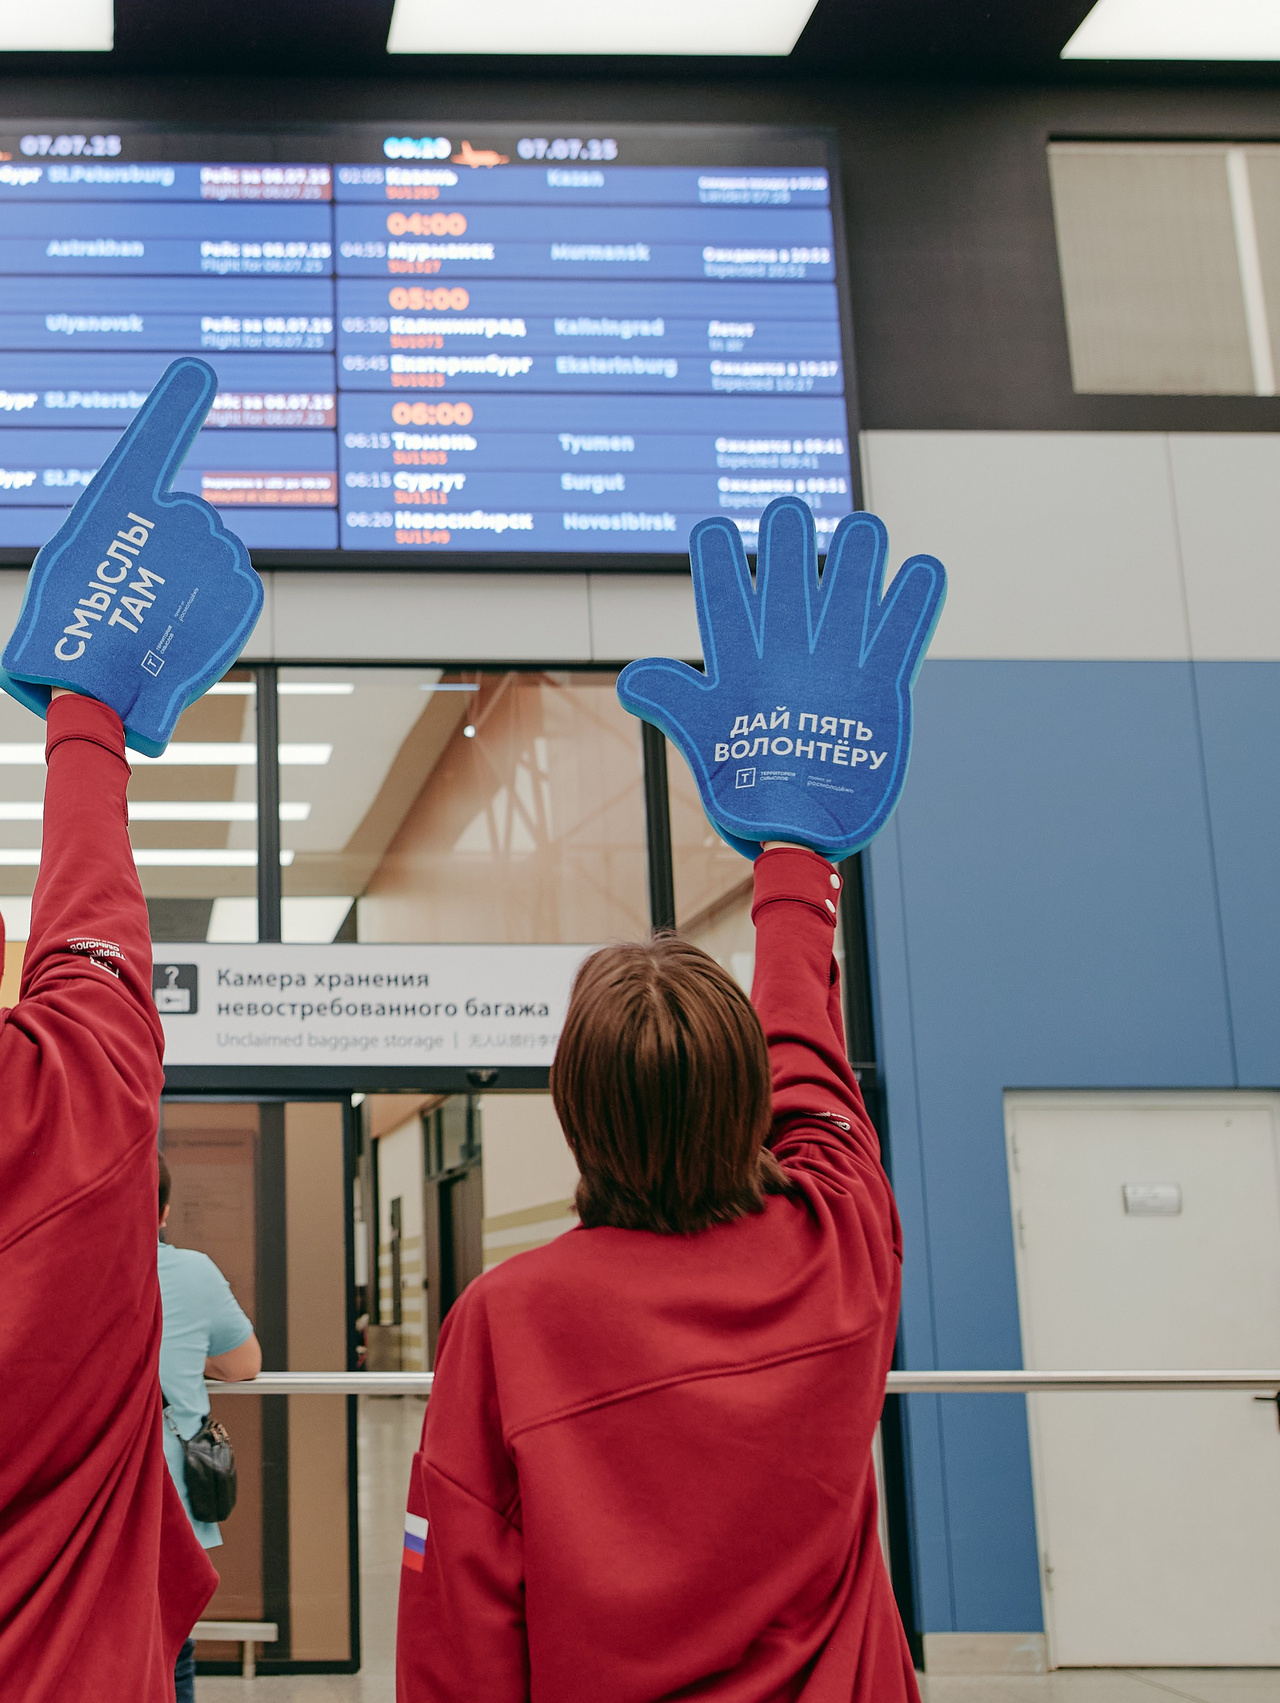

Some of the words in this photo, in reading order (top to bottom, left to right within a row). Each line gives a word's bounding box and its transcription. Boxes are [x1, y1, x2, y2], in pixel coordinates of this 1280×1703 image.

[20, 135, 121, 156] 07.07.25
[386, 211, 467, 236] 04:00
[389, 286, 470, 311] 05:00
[554, 317, 665, 339] Kaliningrad
[390, 354, 534, 377] Екатеринбург
[555, 356, 679, 378] Ekaterinburg
[392, 401, 474, 426] 06:00
[391, 431, 478, 452] Тюмень
[558, 434, 635, 455] Tyumen
[392, 471, 466, 492] Сургут
[560, 473, 625, 494] Surgut
[394, 511, 534, 533] Новосибирск
[563, 513, 678, 532] Novosibirsk
[54, 512, 156, 662] СМЫСЛЫ
[107, 567, 166, 634] ТАМ
[729, 705, 791, 739] ДАЙ
[798, 712, 874, 741] ПЯТЬ
[714, 736, 888, 770] ВОЛОНТЁРУ
[217, 969, 307, 991] Камера
[314, 970, 430, 991] хранения
[217, 998, 458, 1020] невостребованного
[465, 997, 549, 1017] багажа
[216, 1031, 303, 1048] Unclaimed
[307, 1031, 379, 1052] baggage
[383, 1033, 444, 1052] storage
